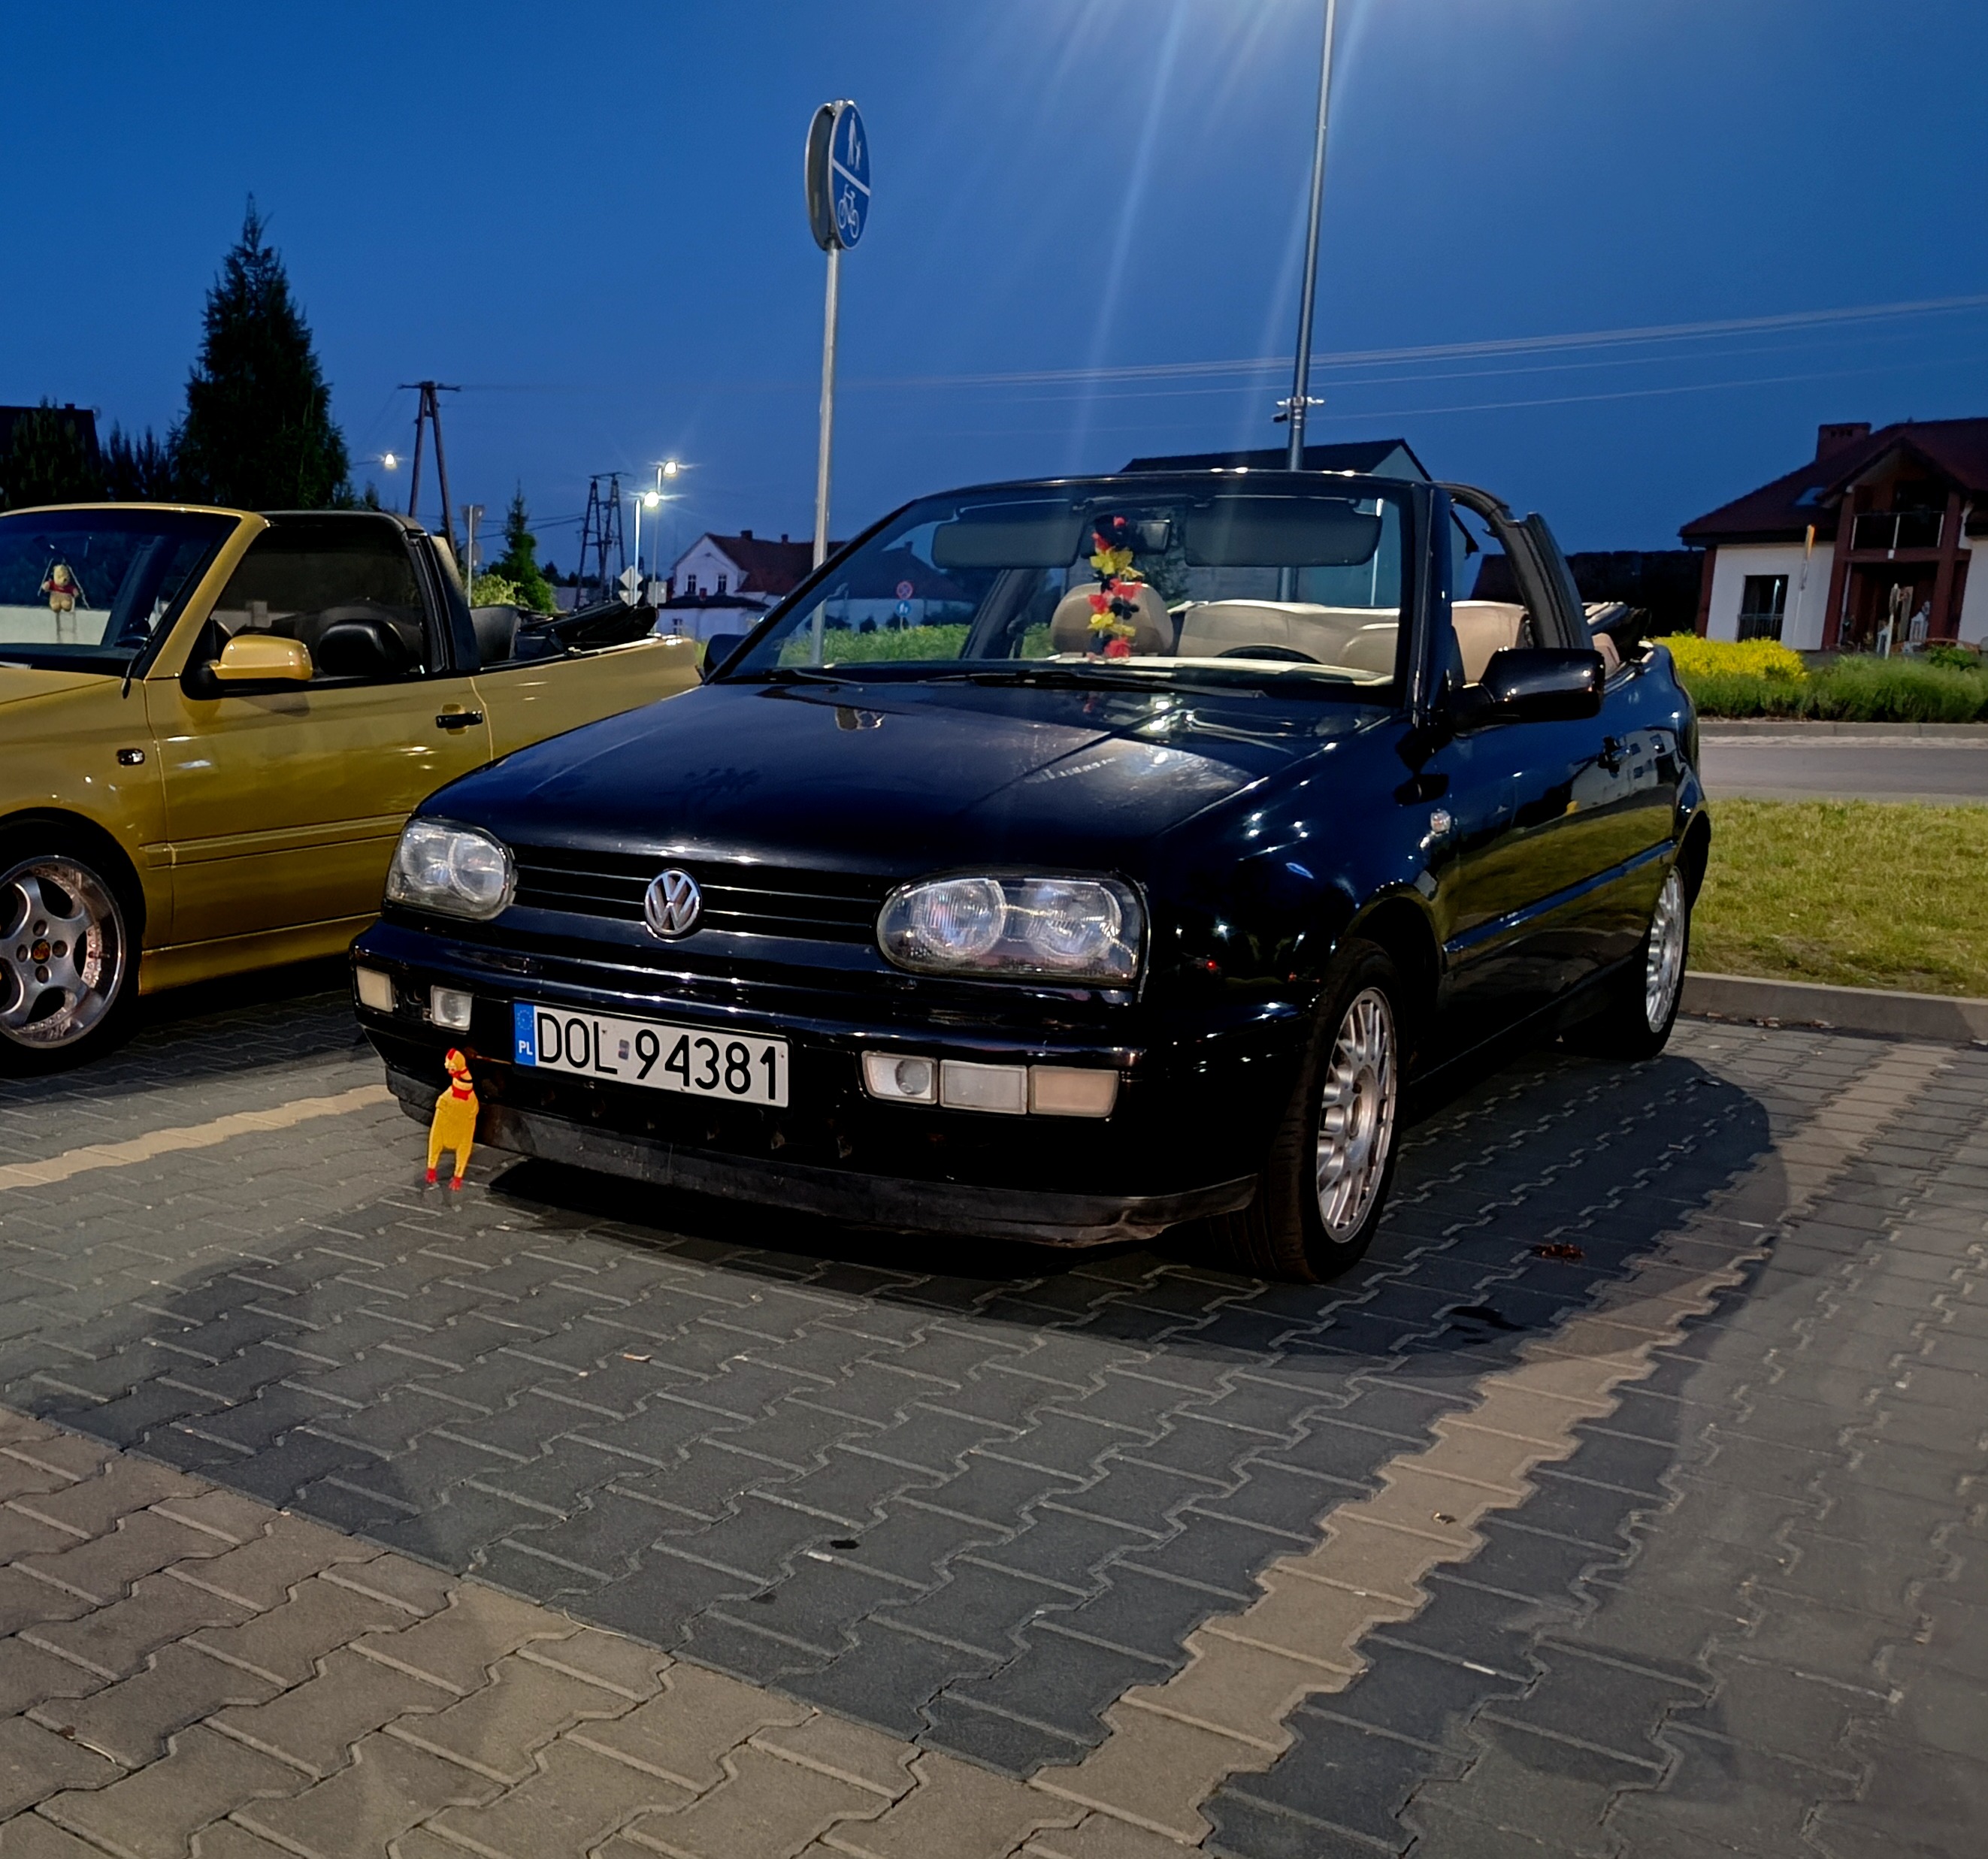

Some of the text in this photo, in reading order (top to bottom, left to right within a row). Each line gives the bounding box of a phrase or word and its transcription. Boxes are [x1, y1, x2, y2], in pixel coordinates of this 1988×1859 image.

[646, 869, 700, 935] VW
[518, 1040, 533, 1056] PL
[537, 1012, 776, 1100] DOL 94381
